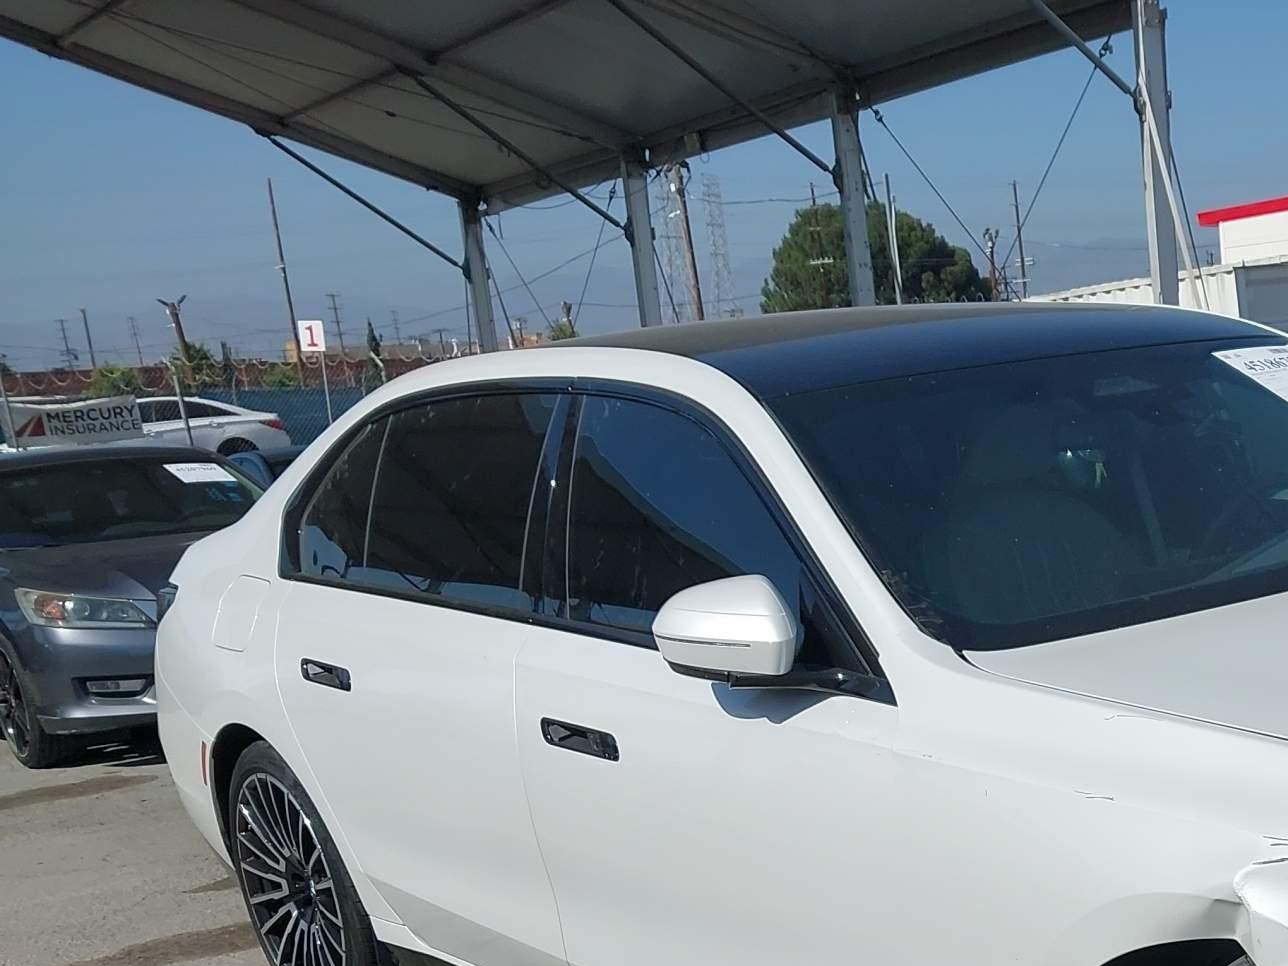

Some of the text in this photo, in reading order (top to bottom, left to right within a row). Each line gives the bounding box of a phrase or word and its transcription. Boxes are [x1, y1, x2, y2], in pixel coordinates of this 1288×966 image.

[304, 324, 319, 347] 1
[46, 404, 135, 423] MERCURY
[48, 418, 142, 437] INSURANCE
